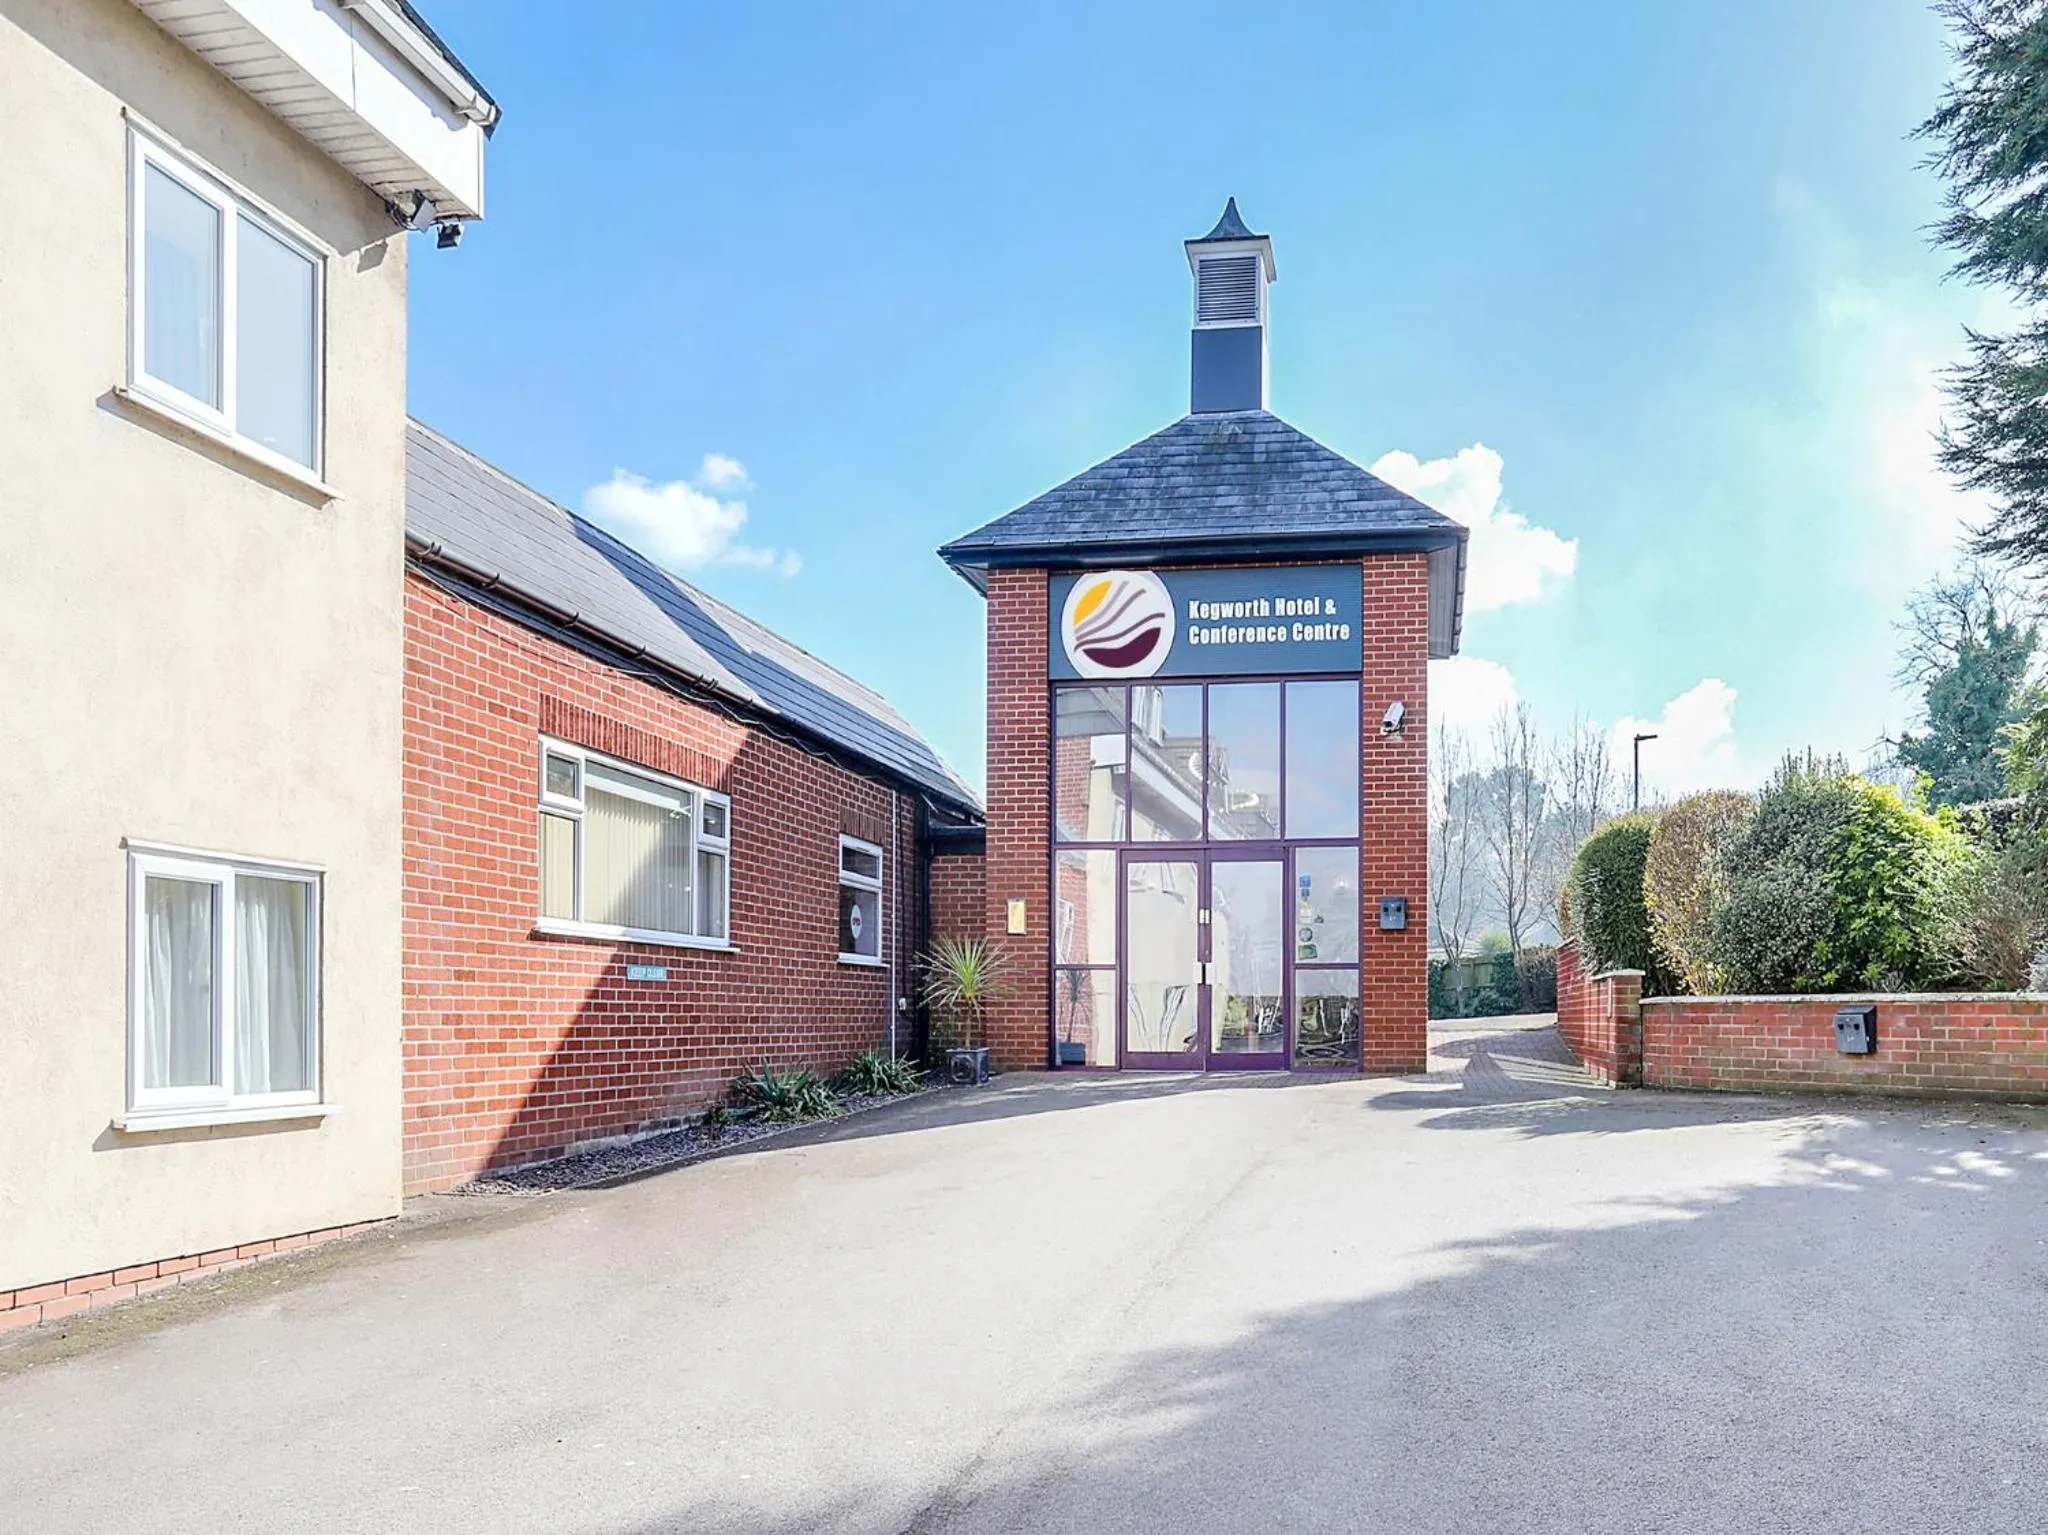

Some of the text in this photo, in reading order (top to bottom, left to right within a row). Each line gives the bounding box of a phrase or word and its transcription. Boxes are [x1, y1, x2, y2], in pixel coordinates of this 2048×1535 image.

[1188, 596, 1337, 620] Kegworth Hotel &
[1188, 622, 1350, 645] Conference Centre
